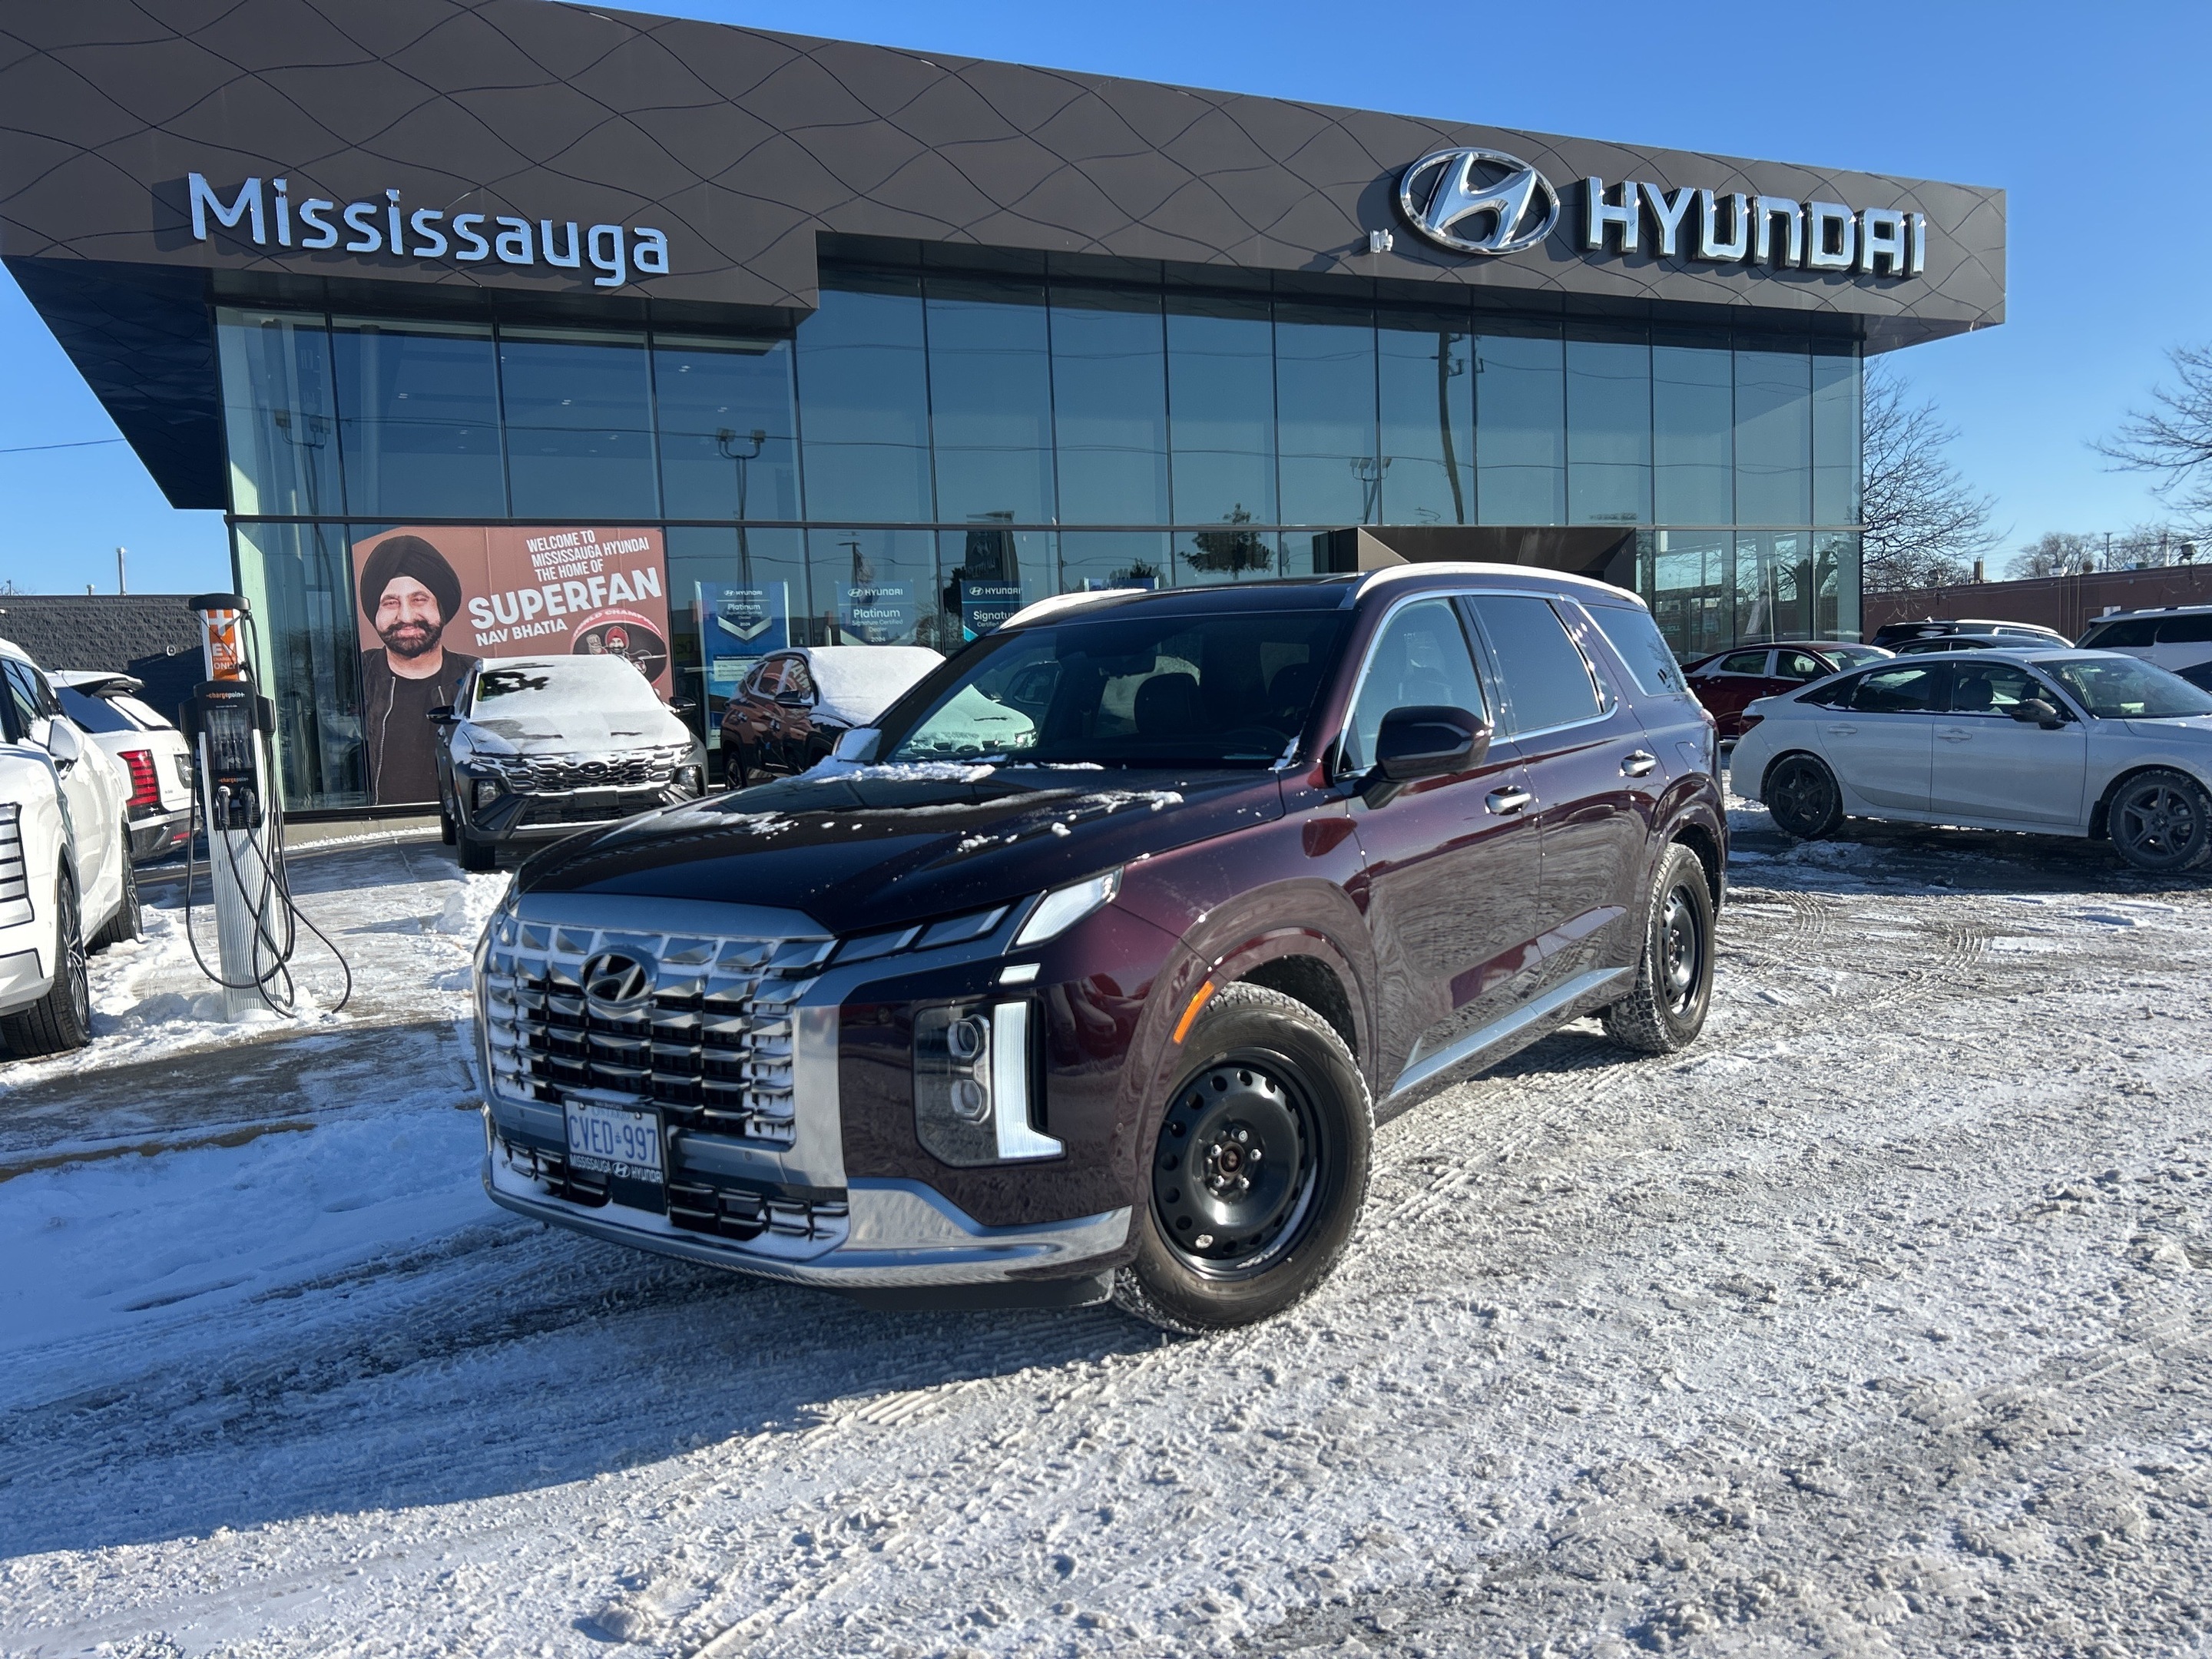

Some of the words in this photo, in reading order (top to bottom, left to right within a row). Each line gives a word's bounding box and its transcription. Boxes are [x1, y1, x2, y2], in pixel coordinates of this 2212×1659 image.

[188, 172, 669, 286] Mississauga
[1586, 177, 1926, 277] HYUNDAI
[526, 532, 580, 553] WELCOME
[581, 530, 595, 544] TO
[531, 544, 603, 568] MISSISSAUGA
[602, 537, 650, 556] HYUNDAI
[535, 567, 558, 582] THE
[558, 561, 590, 578] HOME
[590, 559, 604, 573] OF
[468, 567, 662, 629] SUPERFAN
[727, 603, 761, 611] Platinum
[853, 608, 900, 618] Platinum
[973, 610, 1015, 621] Signatu
[475, 628, 508, 647] NAV
[512, 618, 568, 640] BHATIA
[212, 643, 235, 657] EV
[568, 1114, 614, 1155] CVED
[623, 1124, 657, 1164] 997
[569, 1154, 612, 1174] MISSISSAUGA
[631, 1166, 664, 1184] HYUNDAI
